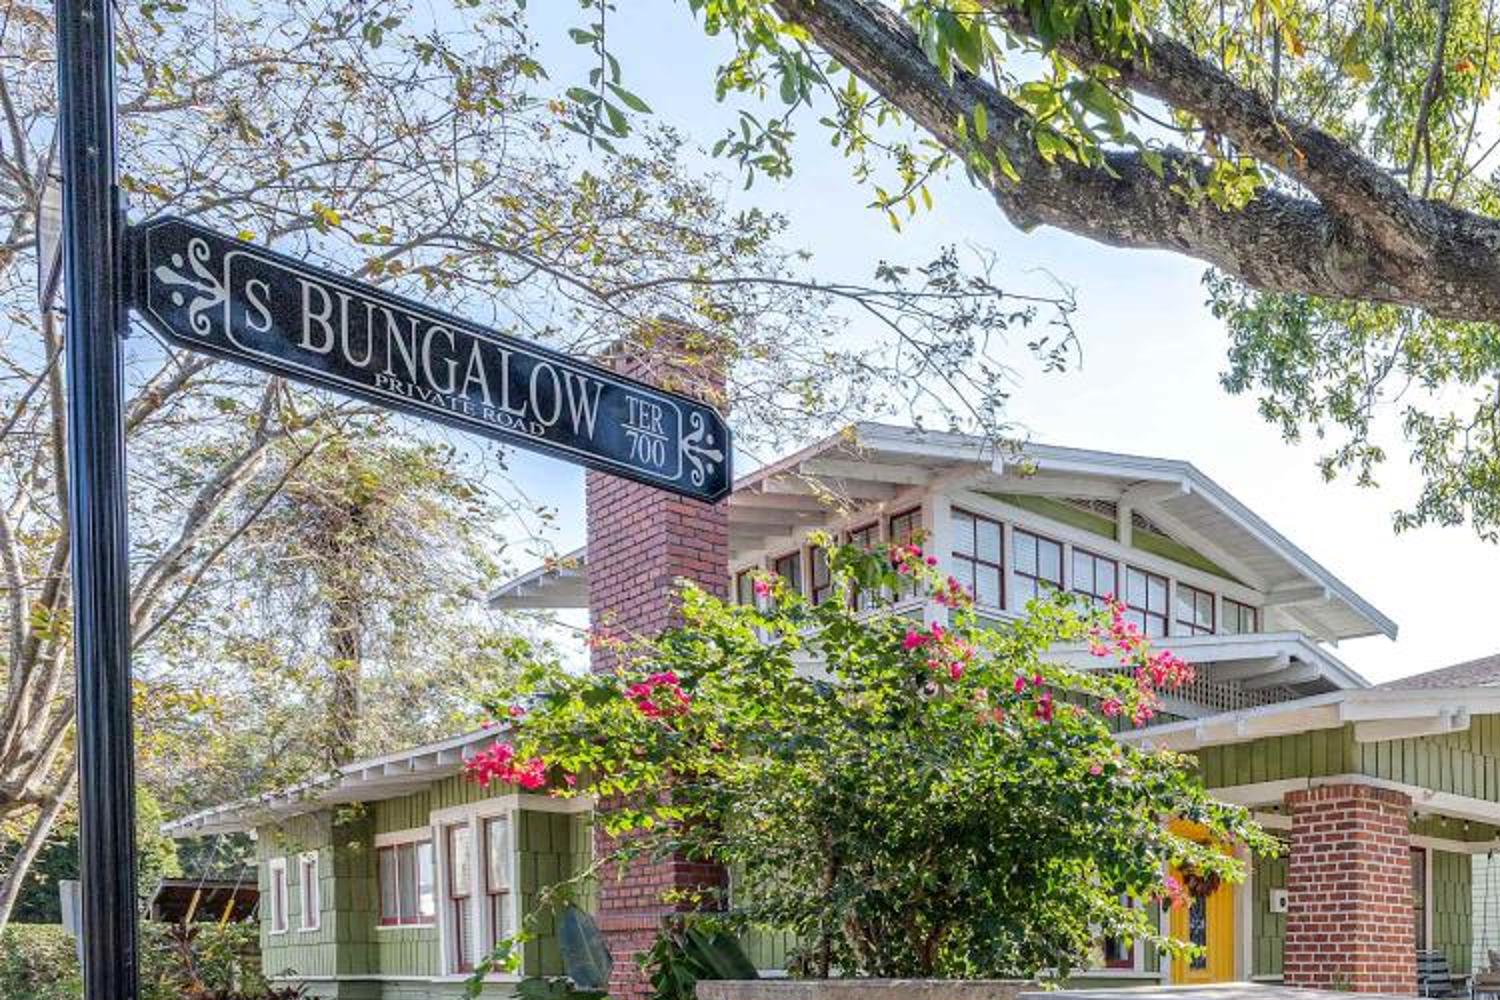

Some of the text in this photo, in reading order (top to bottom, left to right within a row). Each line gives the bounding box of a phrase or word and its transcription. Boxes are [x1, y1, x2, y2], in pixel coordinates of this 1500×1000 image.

[245, 277, 605, 442] S BUNGALOW
[374, 373, 545, 436] PRIVATE ROAD
[625, 395, 665, 435] TER
[626, 430, 665, 467] 700
